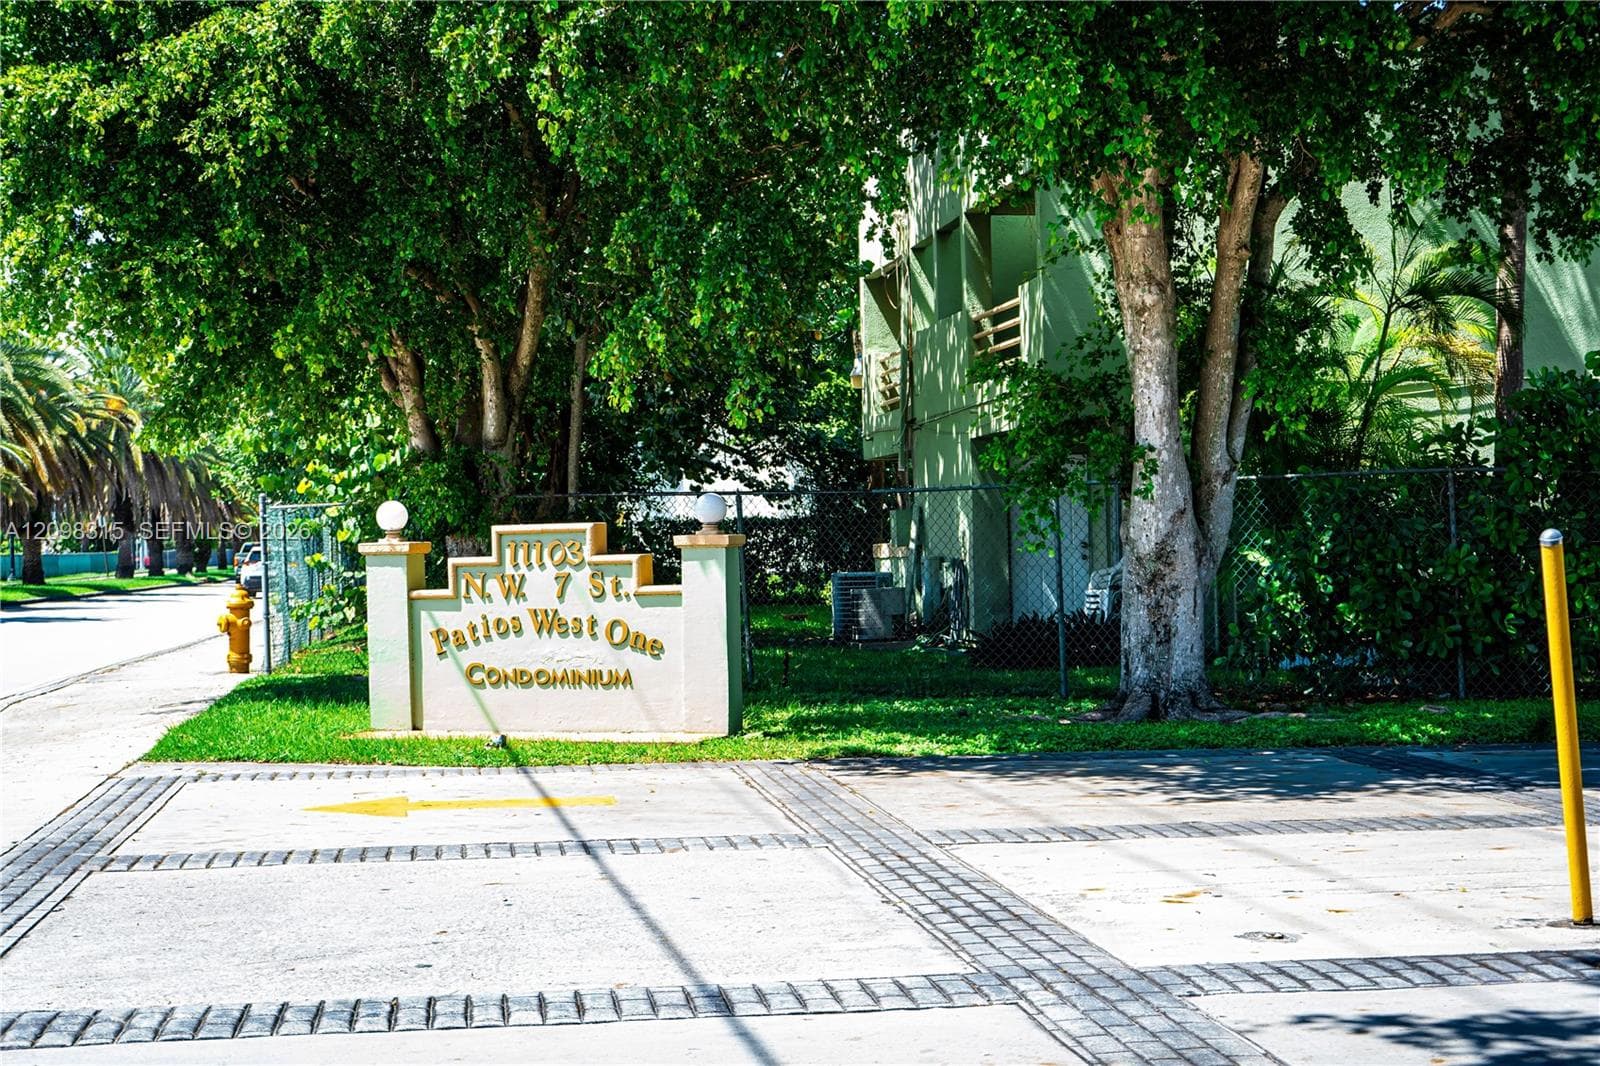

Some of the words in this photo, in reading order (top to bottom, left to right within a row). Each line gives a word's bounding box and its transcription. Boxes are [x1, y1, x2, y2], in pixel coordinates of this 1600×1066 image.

[507, 540, 583, 567] 11103
[462, 572, 525, 600] N.W.
[555, 572, 571, 598] 7
[588, 571, 630, 598] St.
[430, 614, 521, 655] Patios
[527, 607, 597, 636] West
[604, 618, 664, 656] One
